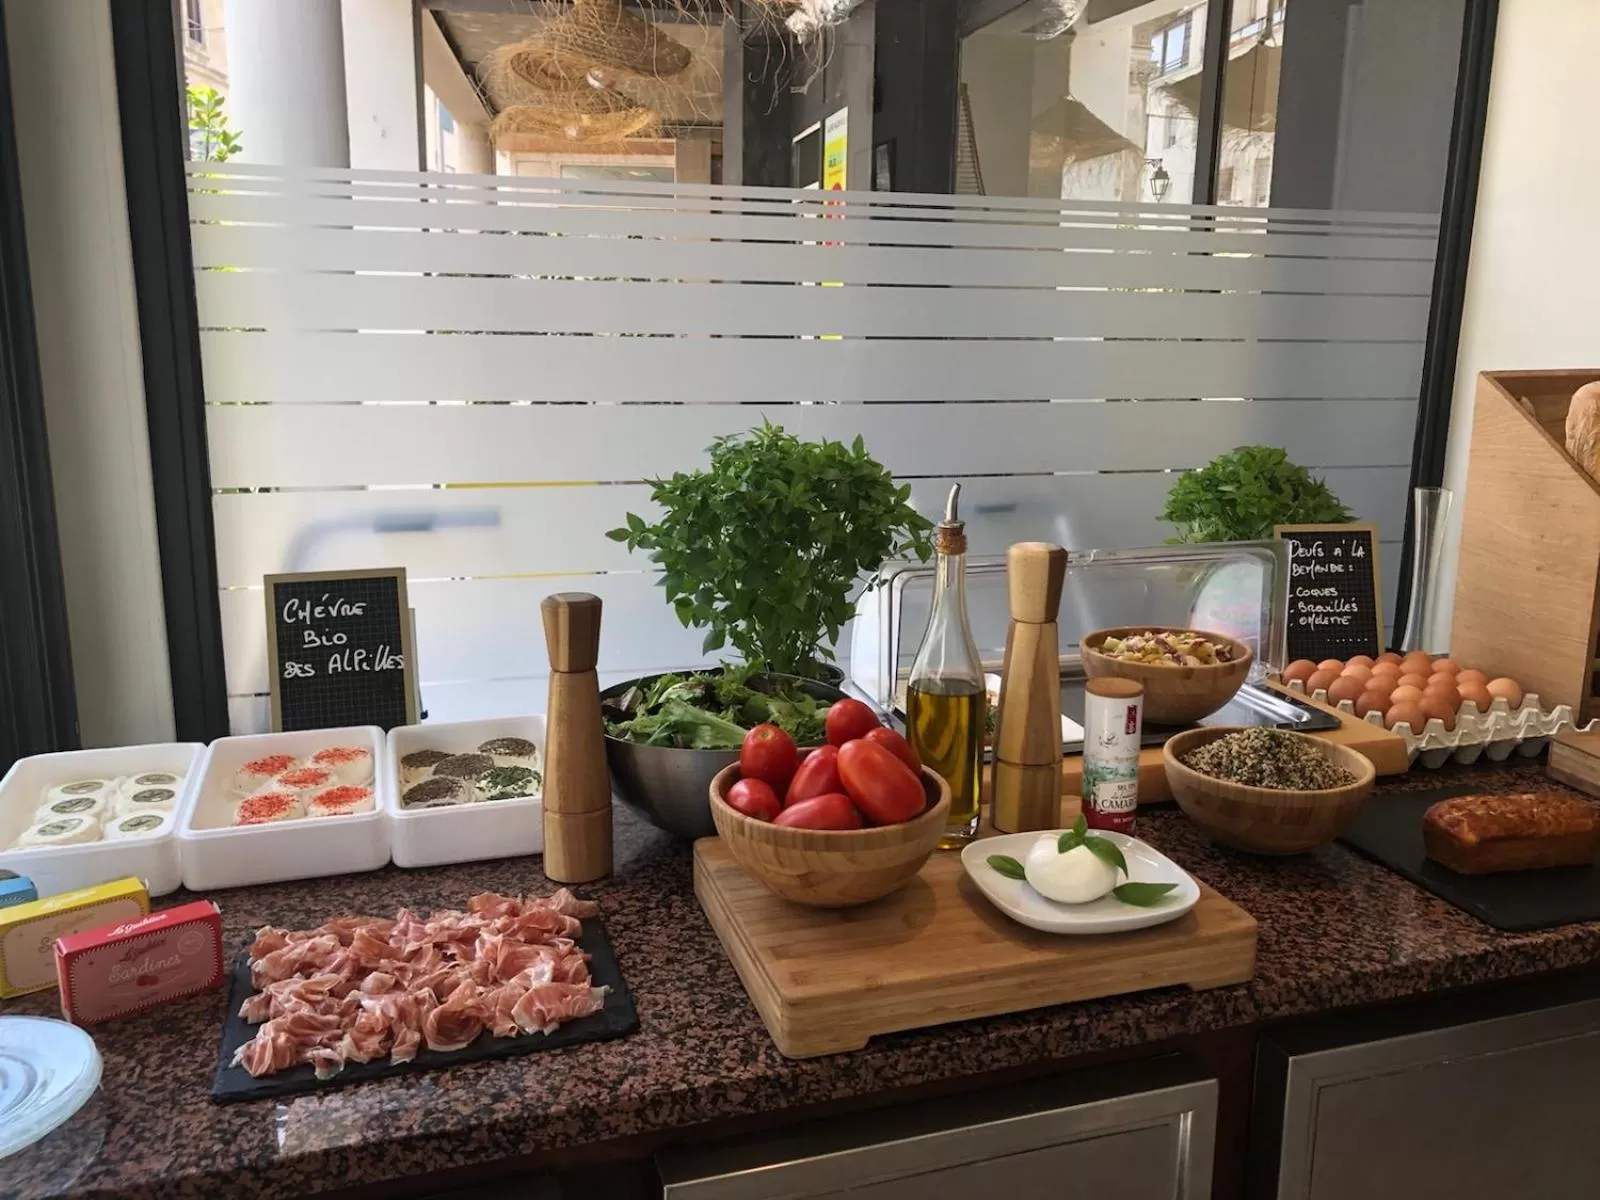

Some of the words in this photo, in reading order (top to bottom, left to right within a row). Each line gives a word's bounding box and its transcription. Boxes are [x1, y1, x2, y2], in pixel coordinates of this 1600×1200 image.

[1352, 540, 1365, 558] LA
[1296, 587, 1338, 598] COQUES
[108, 954, 181, 983] Sardines
